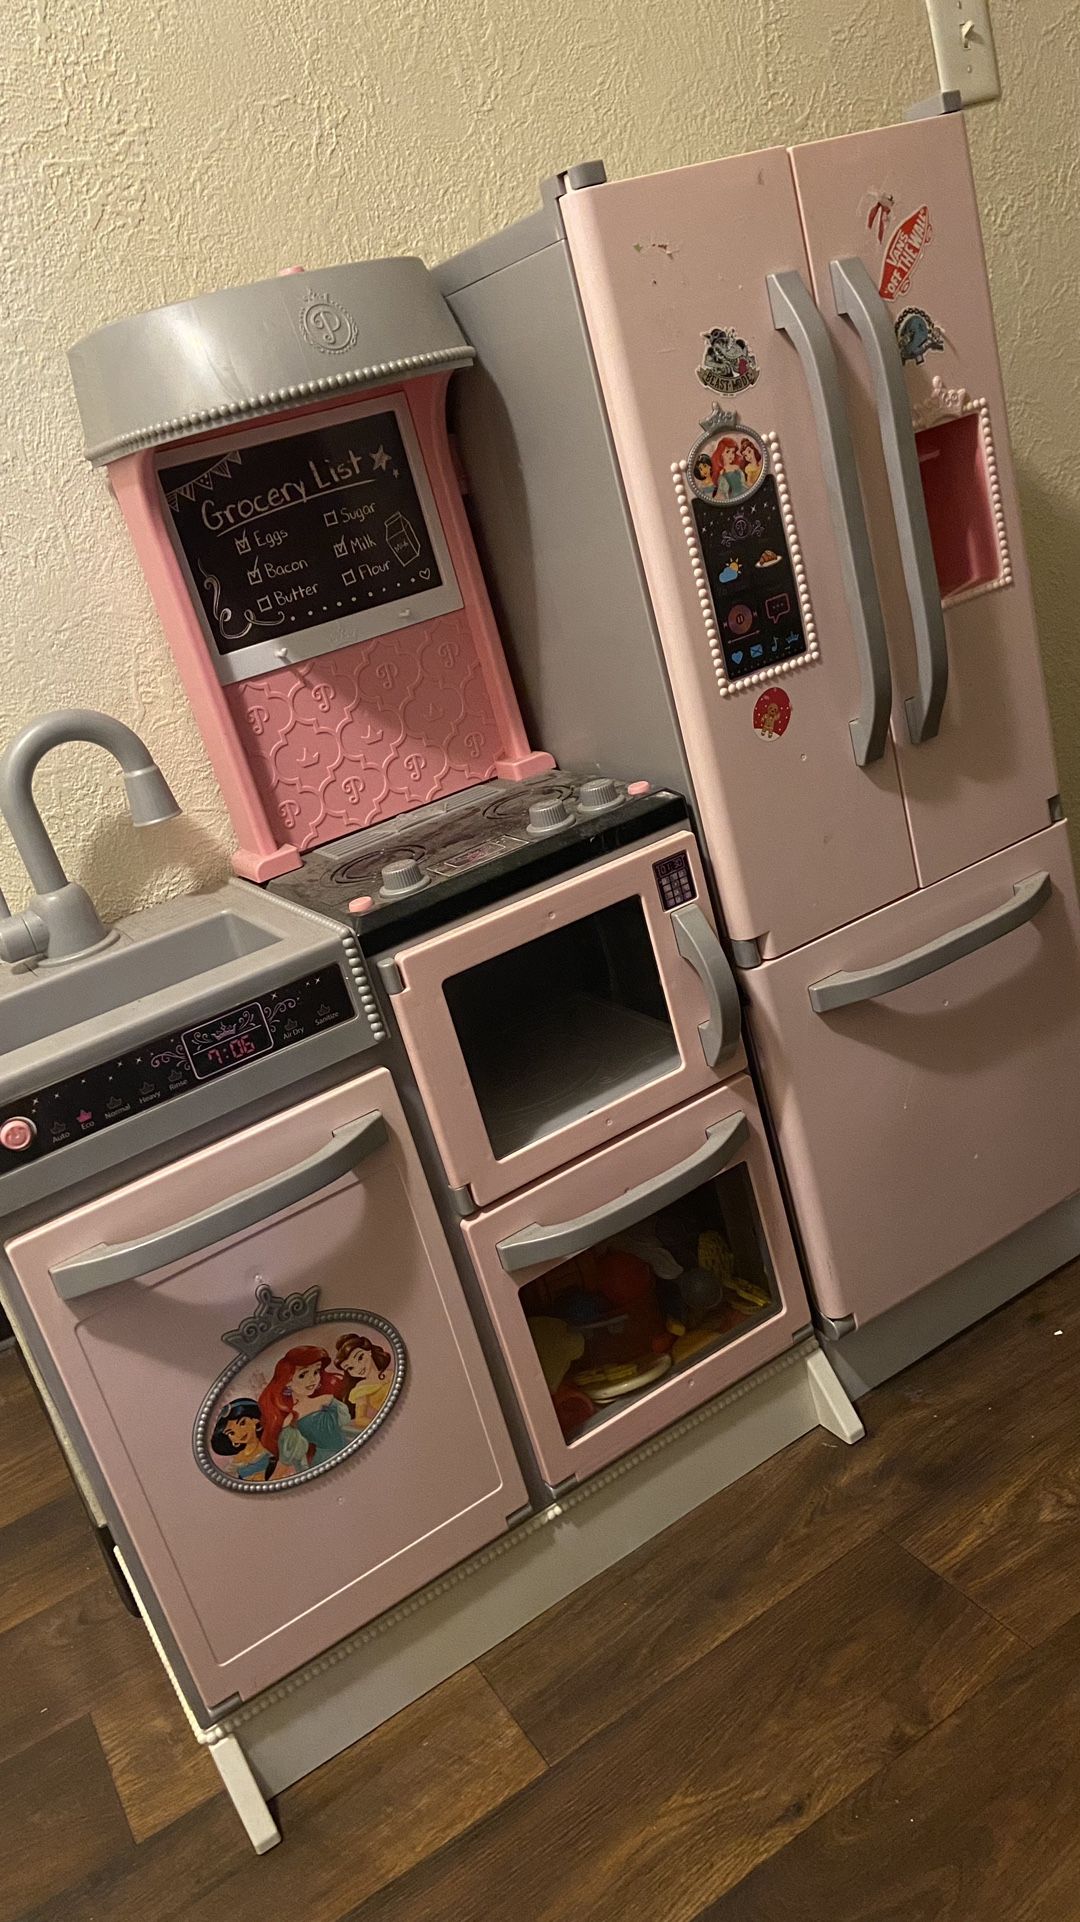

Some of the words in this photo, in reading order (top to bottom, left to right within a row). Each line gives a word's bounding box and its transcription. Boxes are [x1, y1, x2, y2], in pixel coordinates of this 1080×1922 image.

[886, 229, 909, 267] VANS
[897, 243, 918, 272] THE
[201, 480, 307, 531] Grocery
[309, 449, 363, 489] List
[339, 502, 377, 524] Sugar
[253, 529, 289, 548] Eggs
[349, 534, 377, 555] Milk
[264, 558, 309, 578] Bacon
[358, 559, 391, 581] Flour
[273, 582, 319, 607] Butter
[314, 1011, 340, 1026] Sanitize
[283, 1029, 293, 1040] Air
[291, 1025, 304, 1038] Dry
[207, 1035, 256, 1065] 7:06
[168, 1078, 188, 1092] Rinse
[138, 1091, 161, 1104] Heavy
[104, 1104, 131, 1119] Normal
[81, 1120, 95, 1131] Eco
[52, 1130, 70, 1143] Auto
